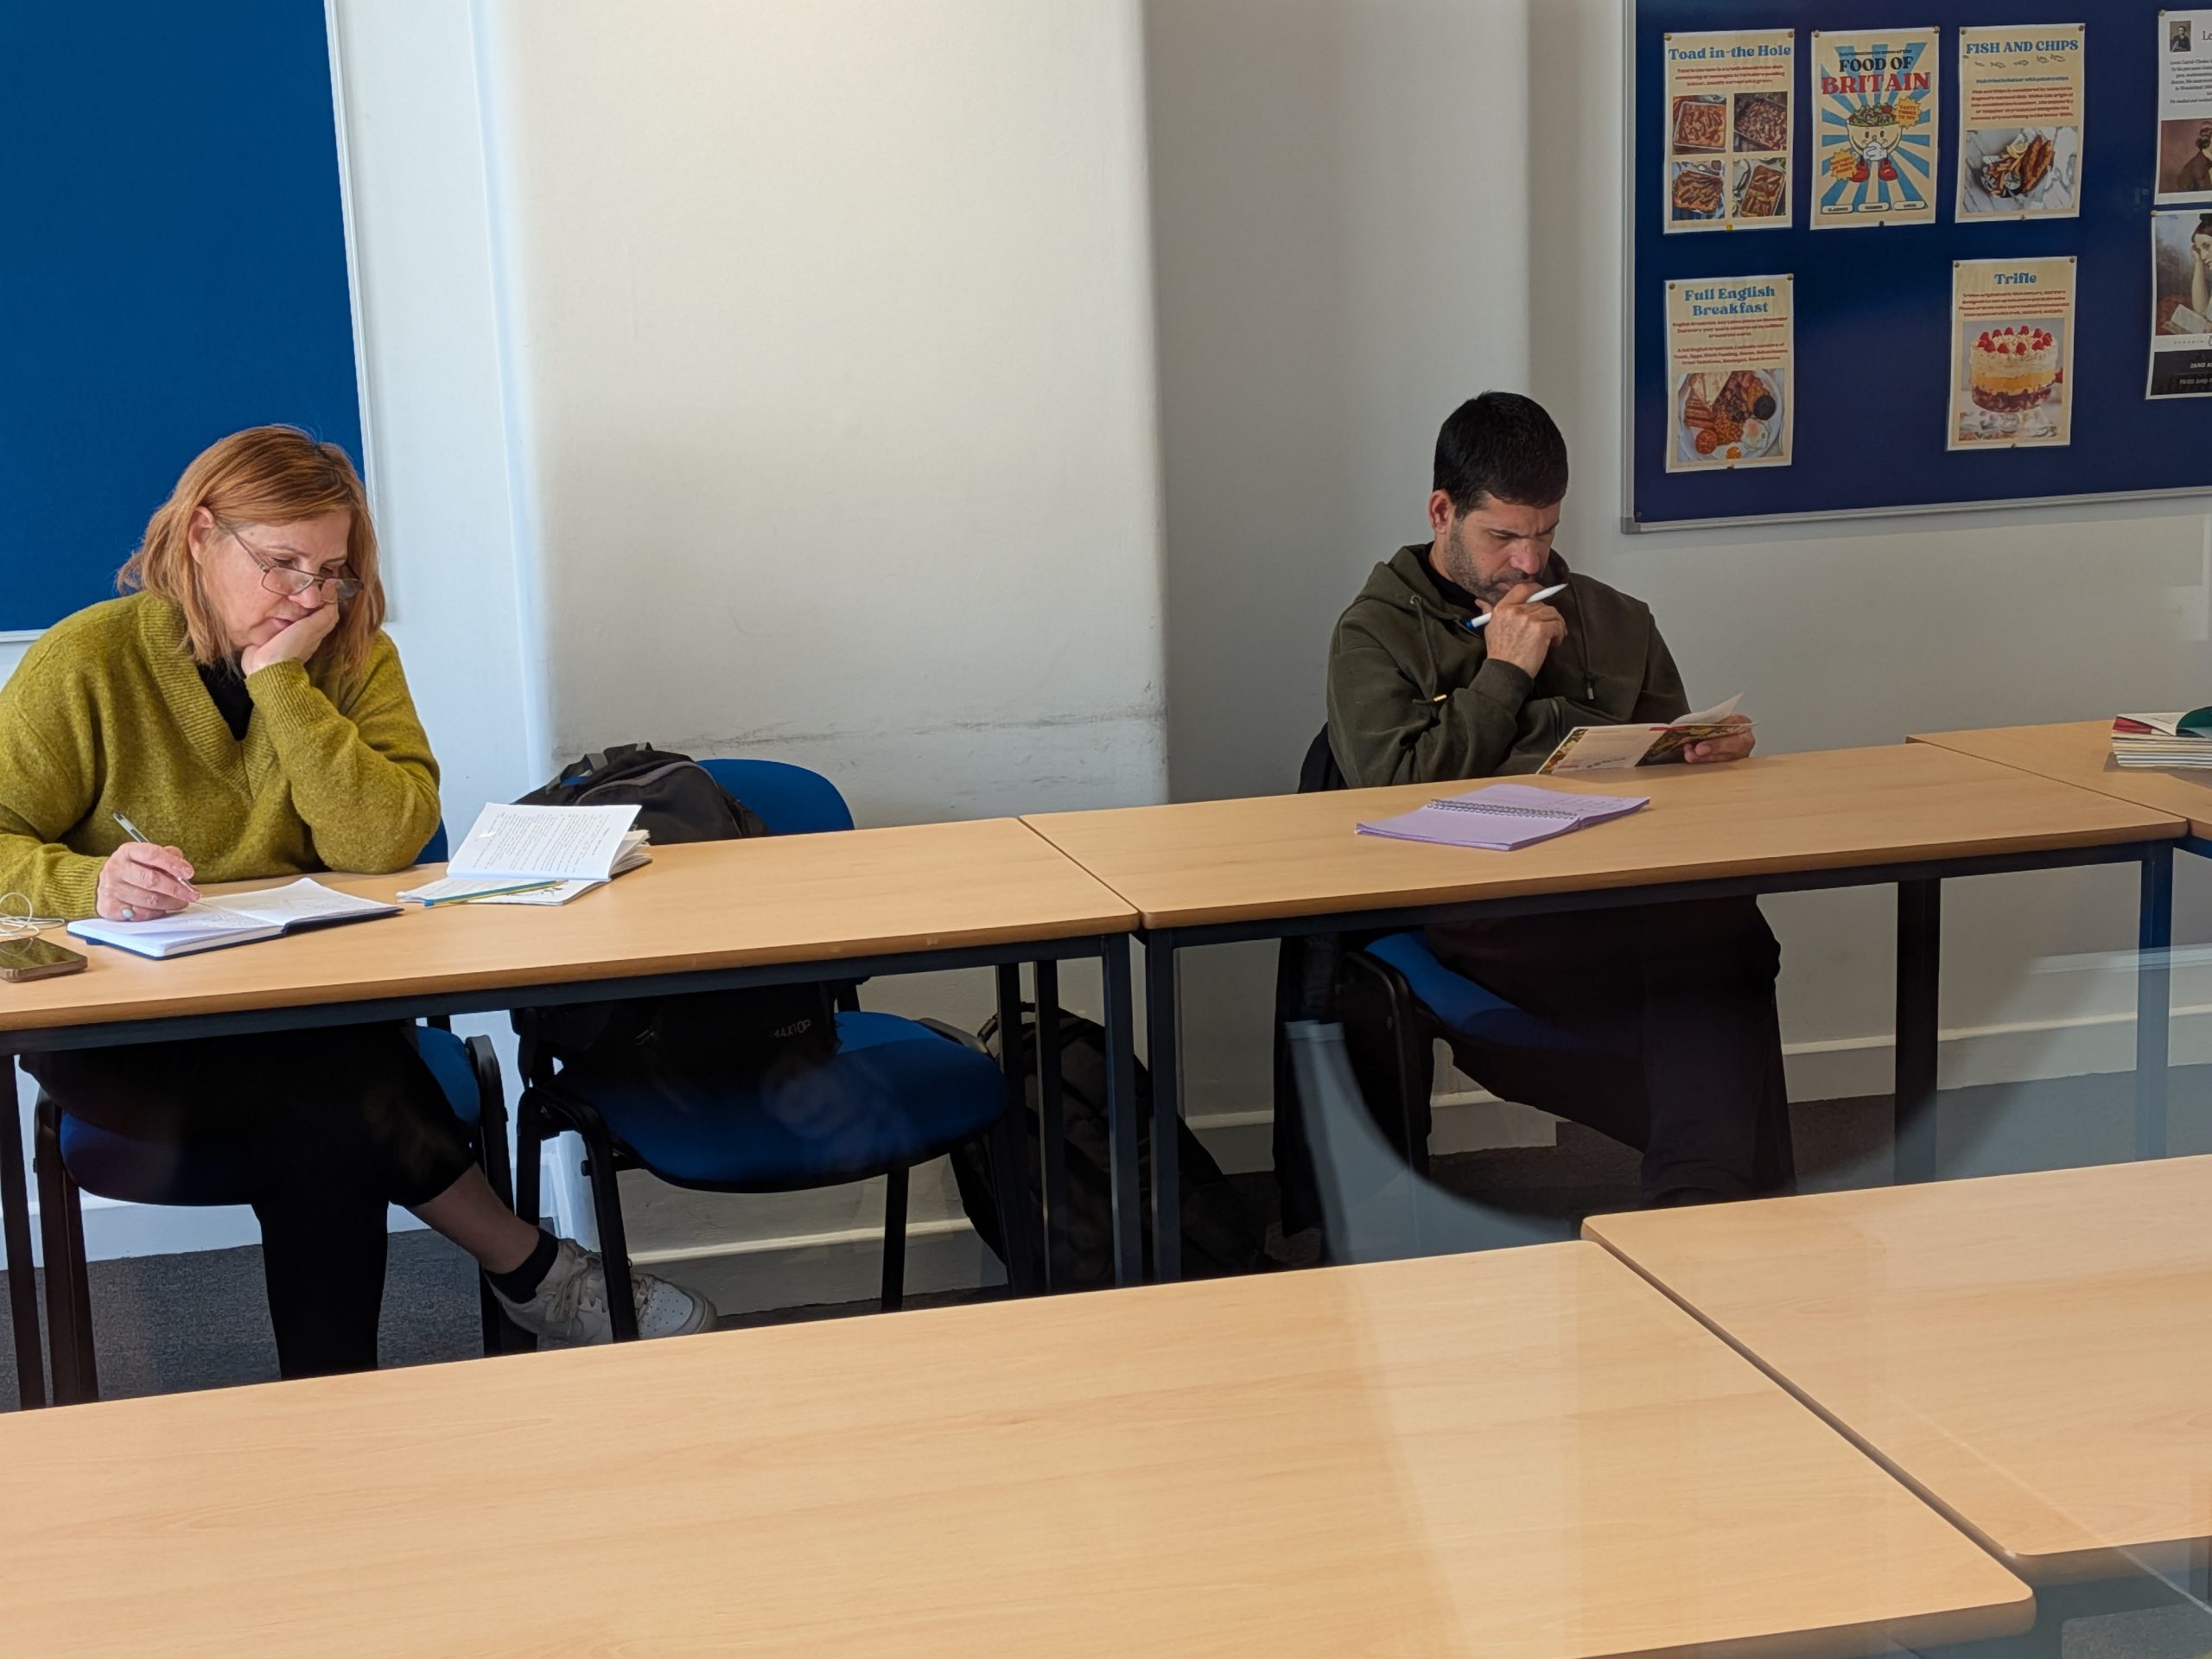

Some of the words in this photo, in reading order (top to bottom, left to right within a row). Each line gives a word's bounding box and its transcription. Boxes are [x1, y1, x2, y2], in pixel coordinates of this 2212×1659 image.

[1669, 47, 1707, 60] Toad
[1758, 45, 1791, 56] Hole
[1966, 42, 2000, 54] FISH
[2003, 41, 2033, 53] AND
[2036, 40, 2079, 51] CHIPS
[1839, 57, 1887, 72] FOOD
[1891, 56, 1914, 70] OF
[1821, 72, 1931, 94] BRITAIN
[1994, 272, 2037, 284] Trifle
[1685, 288, 1715, 301] Full
[1718, 286, 1776, 301] English
[1693, 302, 1769, 316] Breakfast
